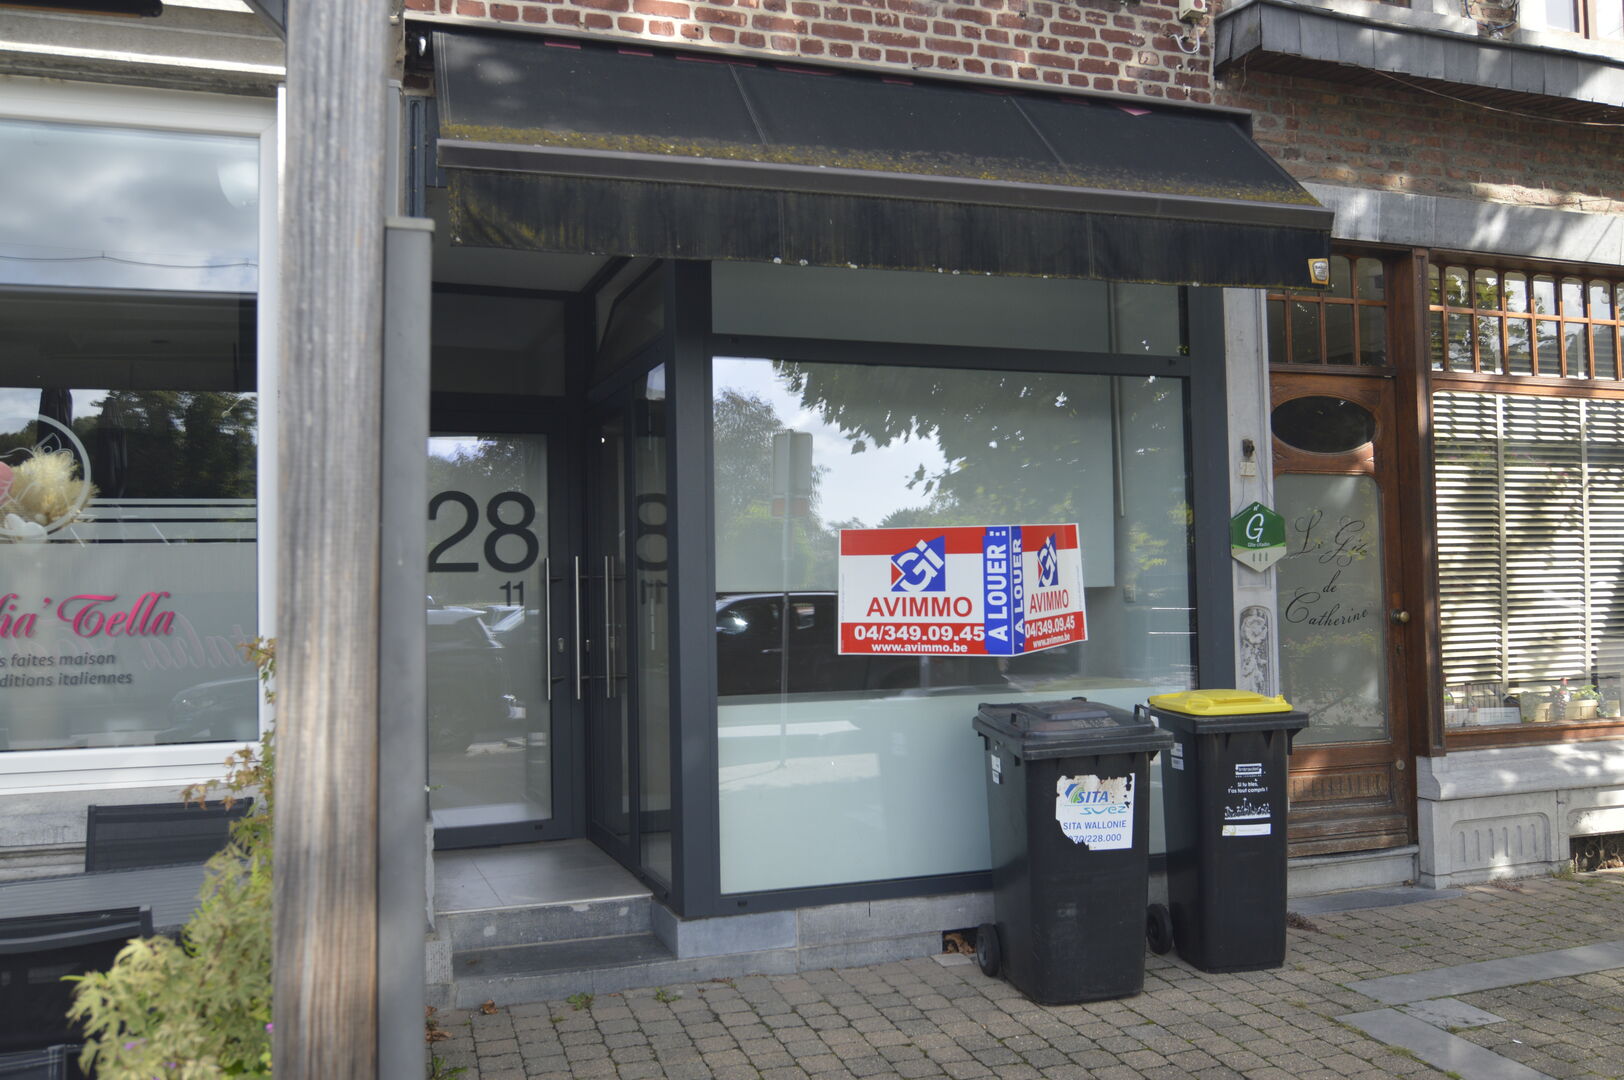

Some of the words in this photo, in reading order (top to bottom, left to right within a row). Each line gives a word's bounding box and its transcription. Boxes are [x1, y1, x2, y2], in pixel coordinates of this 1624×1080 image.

[428, 490, 539, 573] 28
[1246, 513, 1264, 542] G
[987, 543, 1008, 620] LOUER
[1013, 538, 1024, 613] LOUER
[1322, 569, 1341, 593] de
[500, 581, 525, 606] 11
[1029, 589, 1069, 614] AVIMMO
[57, 591, 176, 638] Tella
[866, 596, 973, 618] AVIMMO
[1285, 587, 1369, 626] Catherine
[854, 625, 986, 642] 04/349.09.45
[987, 625, 1008, 642] A
[1014, 618, 1024, 635] A
[1024, 615, 1075, 639] 04/349.09.45
[871, 642, 968, 653] www.avimmo.be
[1032, 633, 1071, 648] www.avimmo.be
[11, 653, 55, 668] faites
[59, 652, 117, 666] maison
[58, 671, 133, 686] italiennes
[1077, 791, 1109, 804] SITA
[1063, 822, 1082, 830] SITA
[1084, 820, 1127, 830] WALLONIE
